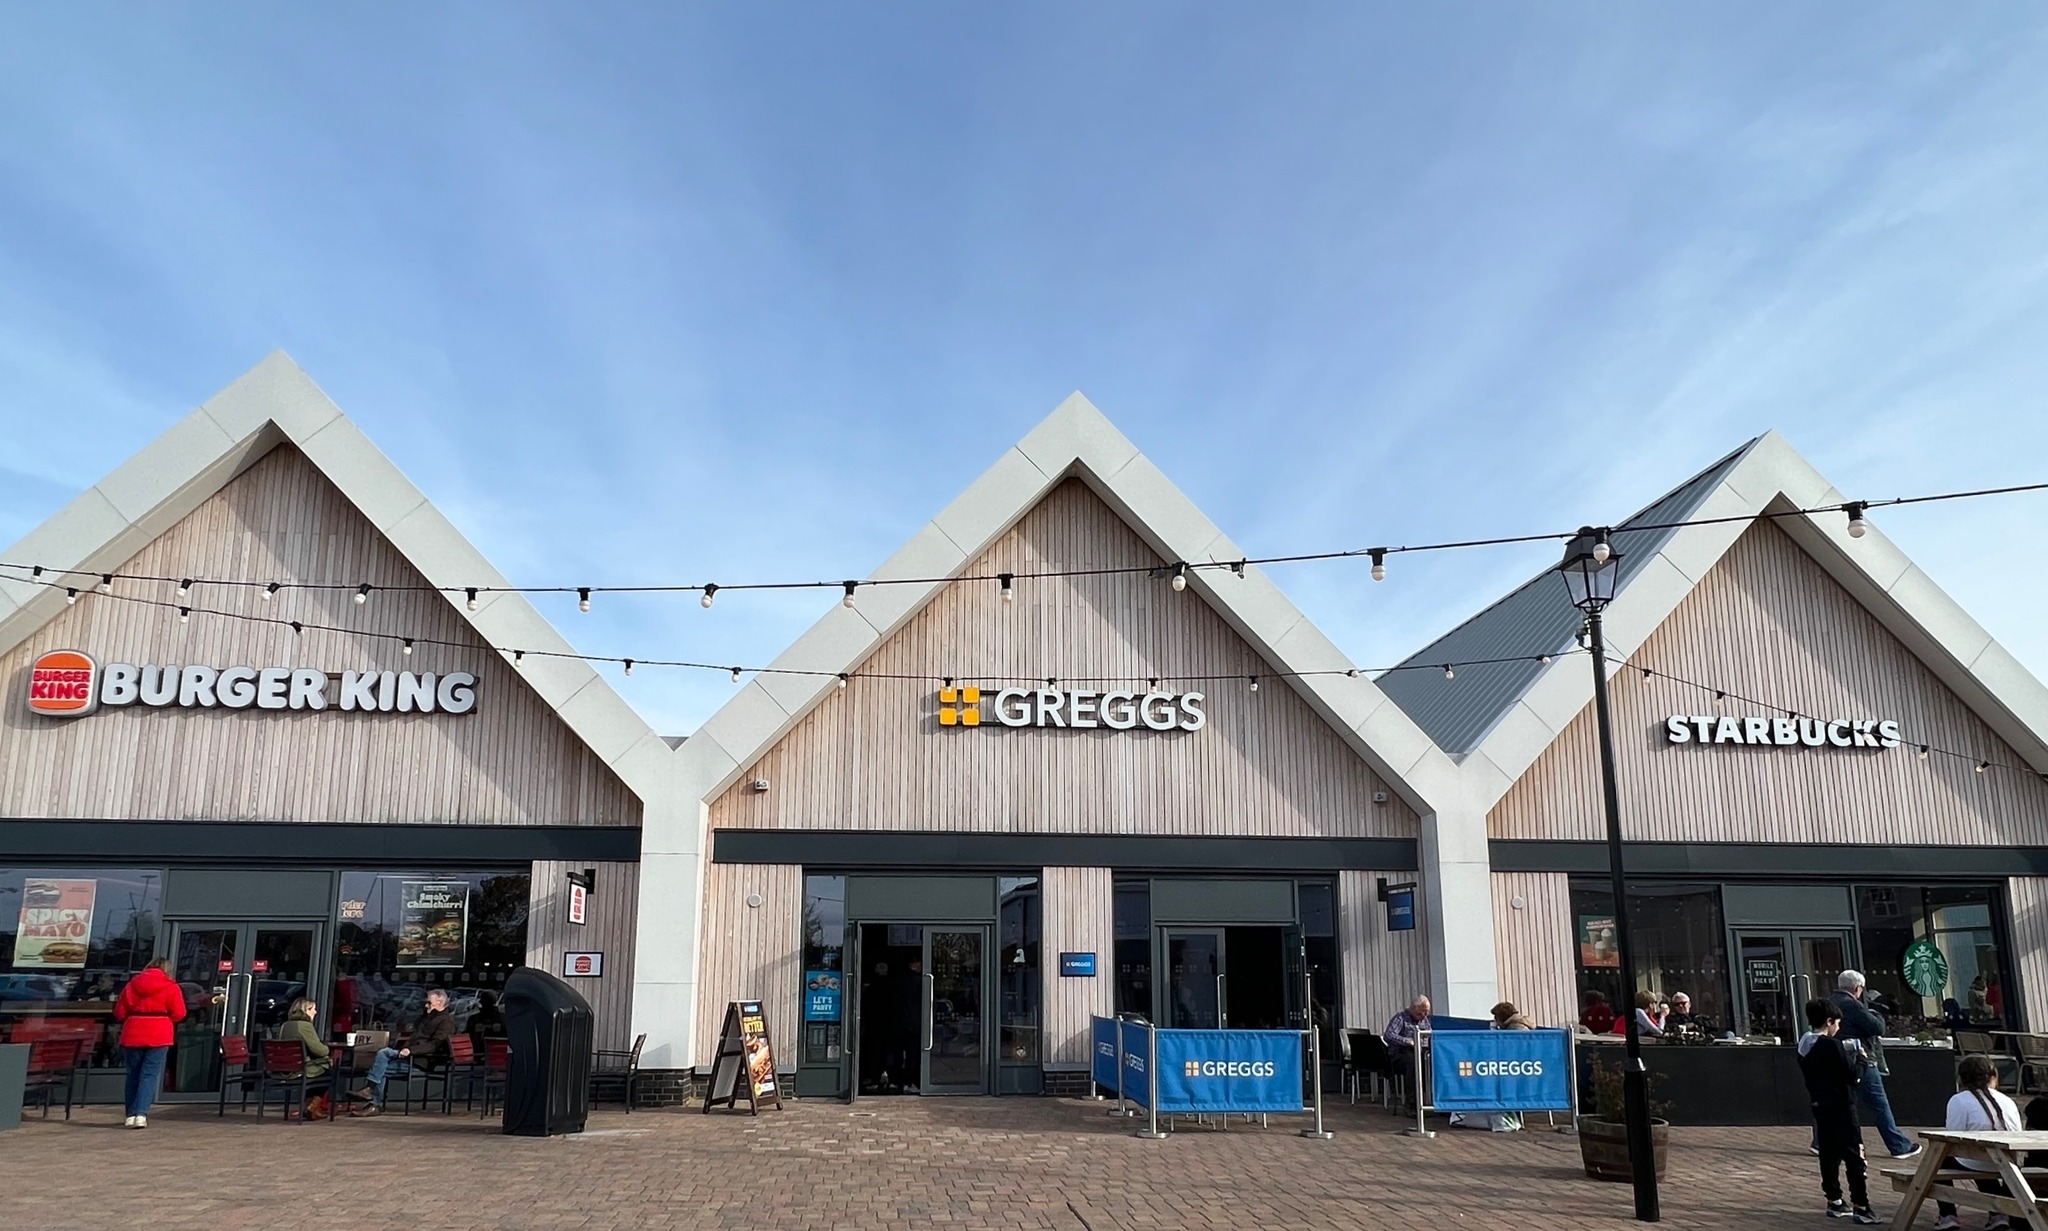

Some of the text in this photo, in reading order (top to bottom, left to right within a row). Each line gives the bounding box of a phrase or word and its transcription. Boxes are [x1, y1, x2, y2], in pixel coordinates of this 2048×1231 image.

[33, 671, 90, 682] BURGER
[31, 683, 89, 699] KING
[102, 662, 477, 714] BURGER KING
[994, 687, 1207, 732] GREGGS
[1667, 715, 1902, 748] STARBUCKS
[420, 893, 451, 902] Smoky
[26, 908, 89, 925] SPICY
[1202, 1061, 1274, 1077] GREGGS
[1475, 1060, 1543, 1076] GREGGS
